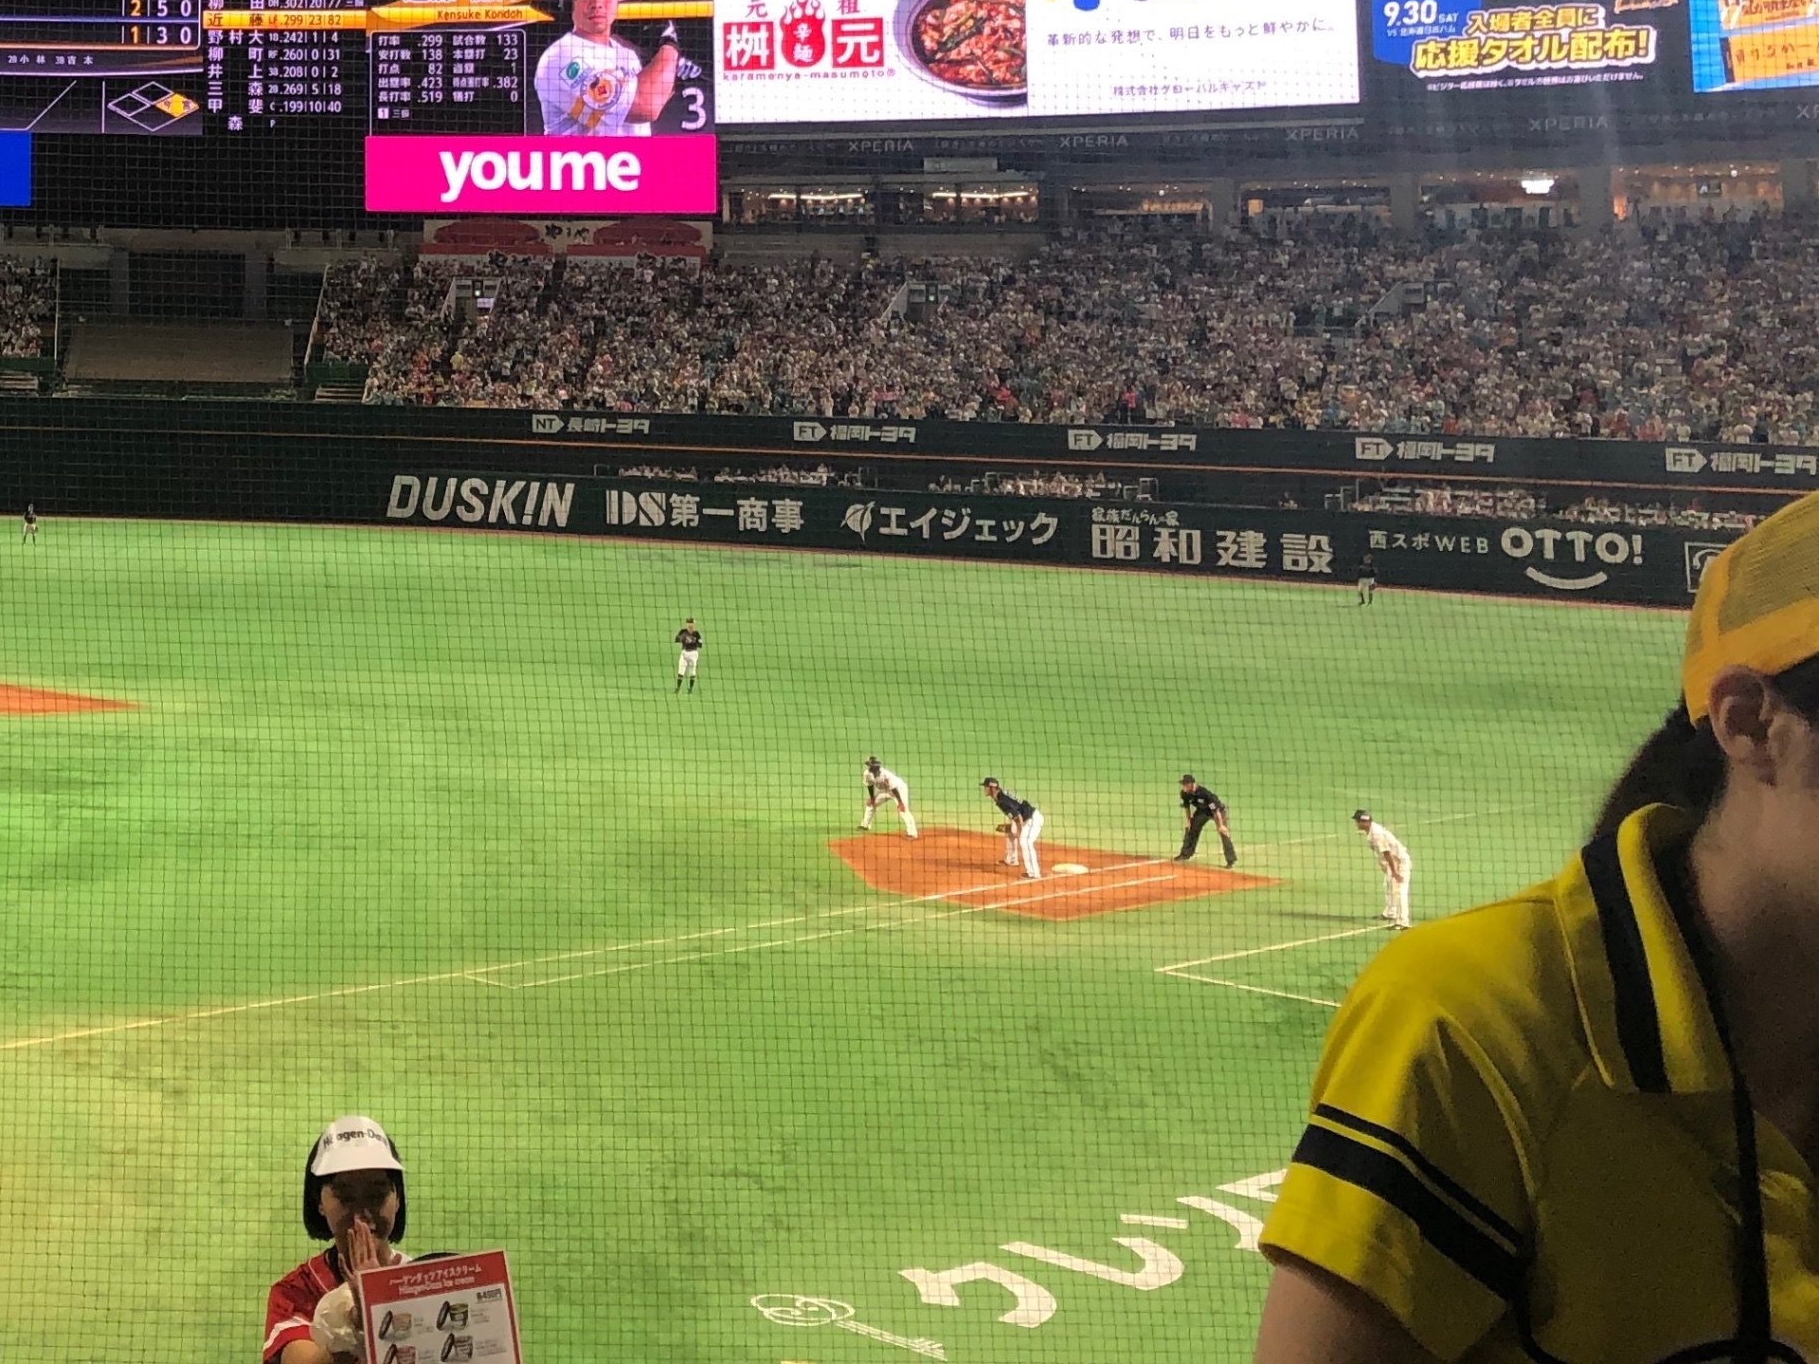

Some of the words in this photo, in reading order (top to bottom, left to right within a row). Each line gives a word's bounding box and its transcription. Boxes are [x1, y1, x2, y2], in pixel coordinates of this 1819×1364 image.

[131, 0, 141, 17] 2
[157, 0, 168, 17] 5
[181, 0, 191, 17] 0
[438, 10, 481, 21] Kensuke
[484, 9, 523, 19] Kondoh
[1439, 12, 1459, 24] SAT
[1467, 7, 1598, 34] 入場者全員に
[156, 26, 167, 44] 3
[180, 26, 191, 44] 0
[279, 32, 302, 43] .242
[417, 35, 443, 47] .299
[497, 35, 518, 46] 133
[279, 49, 302, 61] .260
[422, 49, 443, 60] 138
[503, 49, 518, 60] 23
[1415, 30, 1648, 70] 応援タオル配布!
[279, 66, 303, 77] .208
[428, 64, 443, 75] 82
[279, 84, 303, 95] .269
[418, 77, 443, 88] .423
[493, 77, 518, 88] .382
[417, 91, 443, 103] .519
[279, 101, 303, 112] .199
[682, 87, 707, 130] 3
[1528, 115, 1609, 132] XPERIA
[1286, 127, 1359, 142] XPERIA
[849, 139, 914, 153] XPERIA
[1059, 134, 1128, 150] XPERIA
[669, 493, 804, 534] 第一商事
[880, 506, 1059, 545] エイジェック
[1091, 524, 1334, 574] 昭和建設
[1368, 530, 1490, 554] 西スポWEB
[1500, 527, 1643, 565] OTTO!
